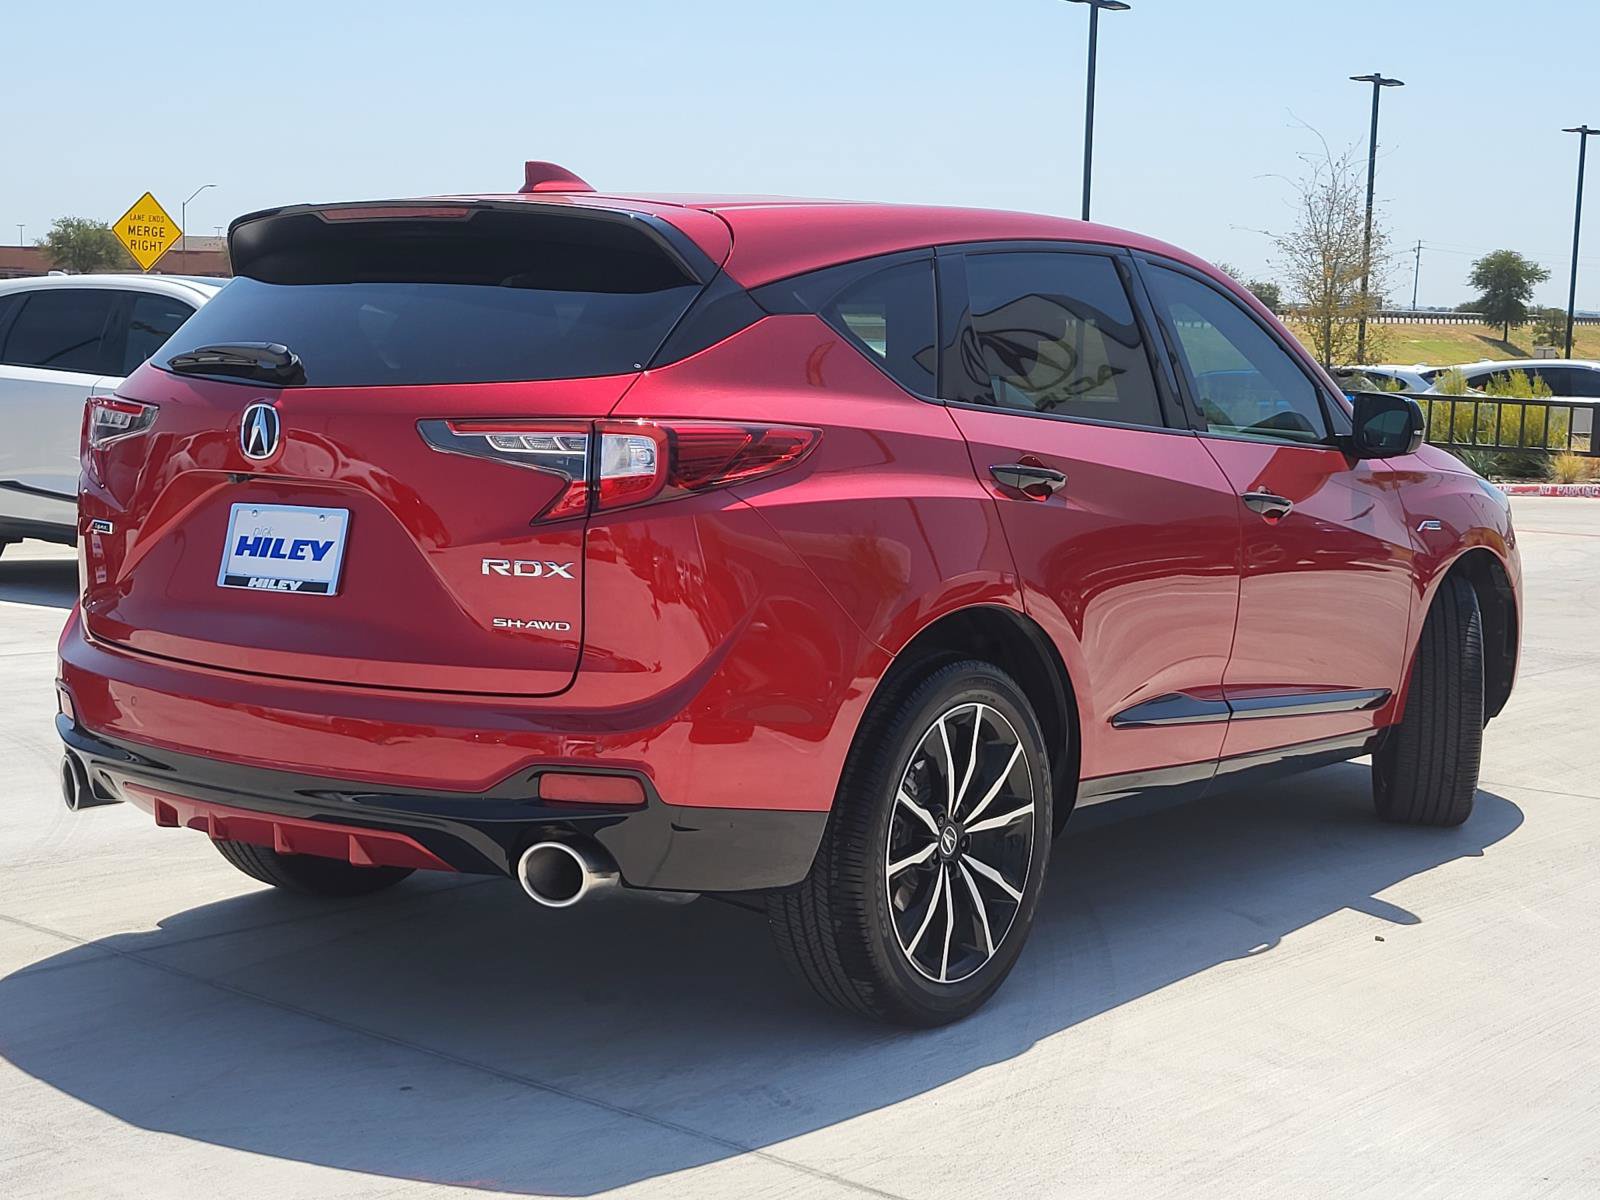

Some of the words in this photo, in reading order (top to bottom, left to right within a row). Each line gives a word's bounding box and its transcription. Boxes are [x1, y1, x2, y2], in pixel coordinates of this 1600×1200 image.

[129, 214, 145, 222] LANE
[148, 215, 164, 223] ENDS
[128, 225, 166, 238] MERGE
[130, 239, 164, 251] RIGHT
[234, 535, 335, 562] HILEY
[481, 558, 576, 579] RDX
[248, 577, 303, 590] HILEY
[492, 618, 571, 631] SH-AWD
